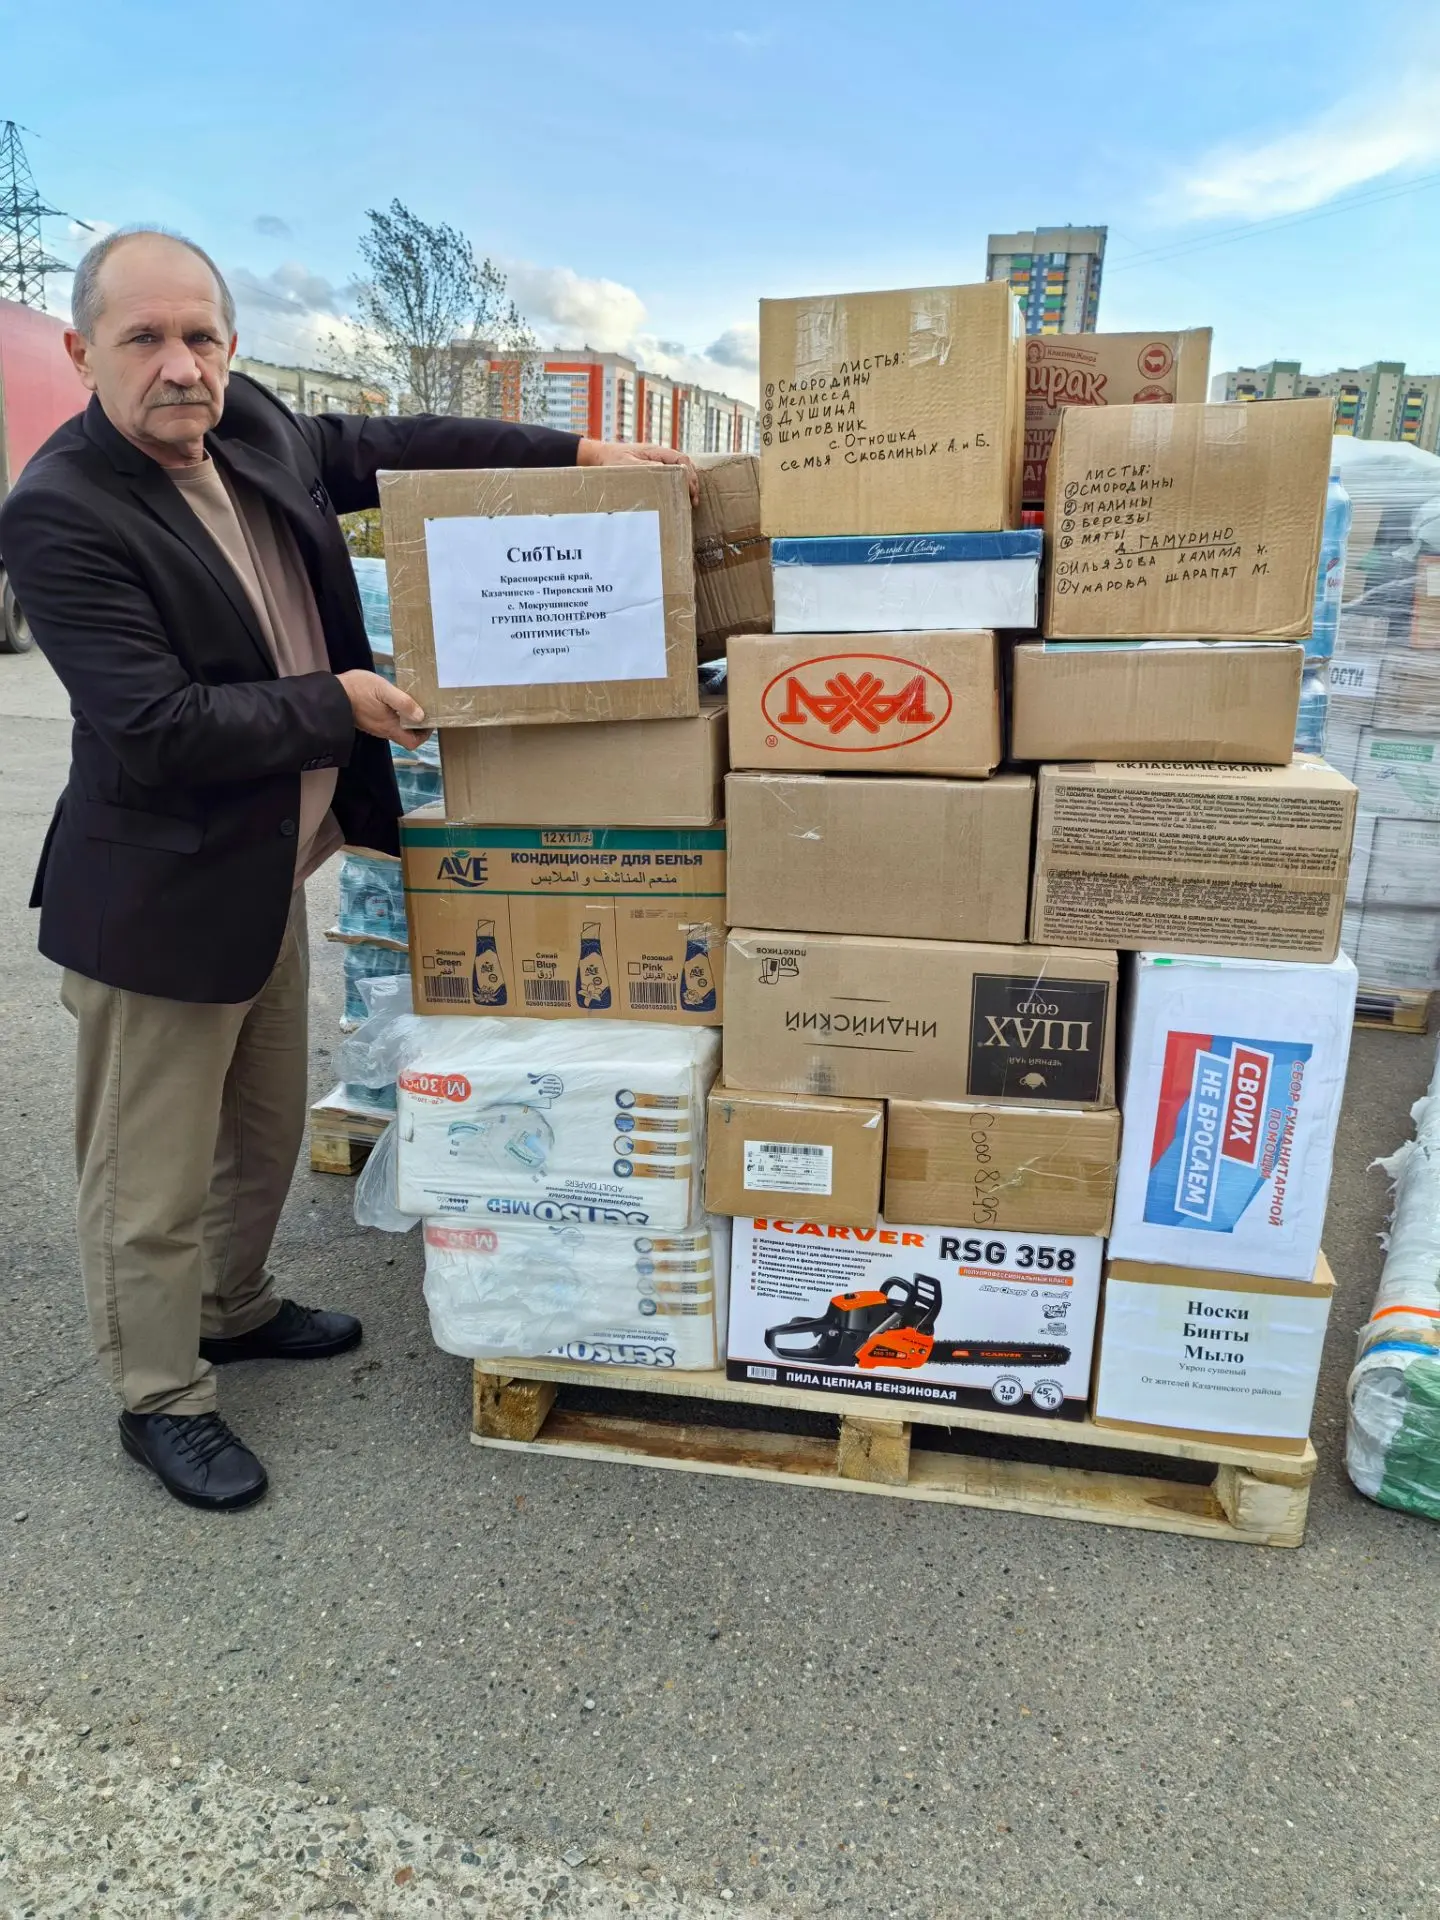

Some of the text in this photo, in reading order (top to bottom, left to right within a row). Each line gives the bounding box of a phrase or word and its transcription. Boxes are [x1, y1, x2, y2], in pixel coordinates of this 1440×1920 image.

[506, 545, 583, 564] СибТыл
[500, 572, 593, 585] Красноярский край,
[481, 587, 535, 599] Казачинско
[542, 585, 594, 597] Пировский
[595, 583, 613, 594] МО
[518, 599, 589, 612] Мокрушинское
[491, 610, 607, 625] ГРУППА ВОЛОНТЁРОВ
[510, 627, 590, 640] «ОПТИМИСТЫ»
[532, 645, 570, 656] (сухари)
[511, 852, 703, 868] КОНДИЦИОНЕР ДЛЯ БЕЛЬЯ
[756, 948, 807, 956] пакетиков
[436, 957, 462, 968] Green
[536, 959, 557, 970] Blue
[642, 961, 664, 972] Pink
[780, 957, 798, 968] 100
[1017, 1002, 1059, 1016] GOLD
[785, 1010, 938, 1038] ИНДИЙСКИЙ
[984, 1014, 1094, 1052] ШАХ
[420, 1076, 438, 1092] 30
[447, 1080, 466, 1097] M
[1228, 1061, 1261, 1144] СВОИХ
[1185, 1067, 1223, 1204] НЕ БРОСАЕМ
[1267, 1106, 1299, 1228] ГУМАНИТАРНОЙ
[564, 1180, 597, 1191] DIAPERS
[599, 1183, 624, 1193] ADULT
[939, 1235, 1077, 1272] RSG 358
[1187, 1300, 1249, 1321] Носки
[1182, 1322, 1250, 1343] Бинты
[1184, 1344, 1244, 1364] Мыло
[1179, 1361, 1247, 1377] Укроп сушеный
[786, 1371, 957, 1401] ПИЛА ЦЕПНАЯ БЕНЗИНОВАЯ
[1000, 1385, 1016, 1395] 3.0
[1141, 1375, 1282, 1398] От жителей Казачинского района
[1002, 1394, 1013, 1402] HP
